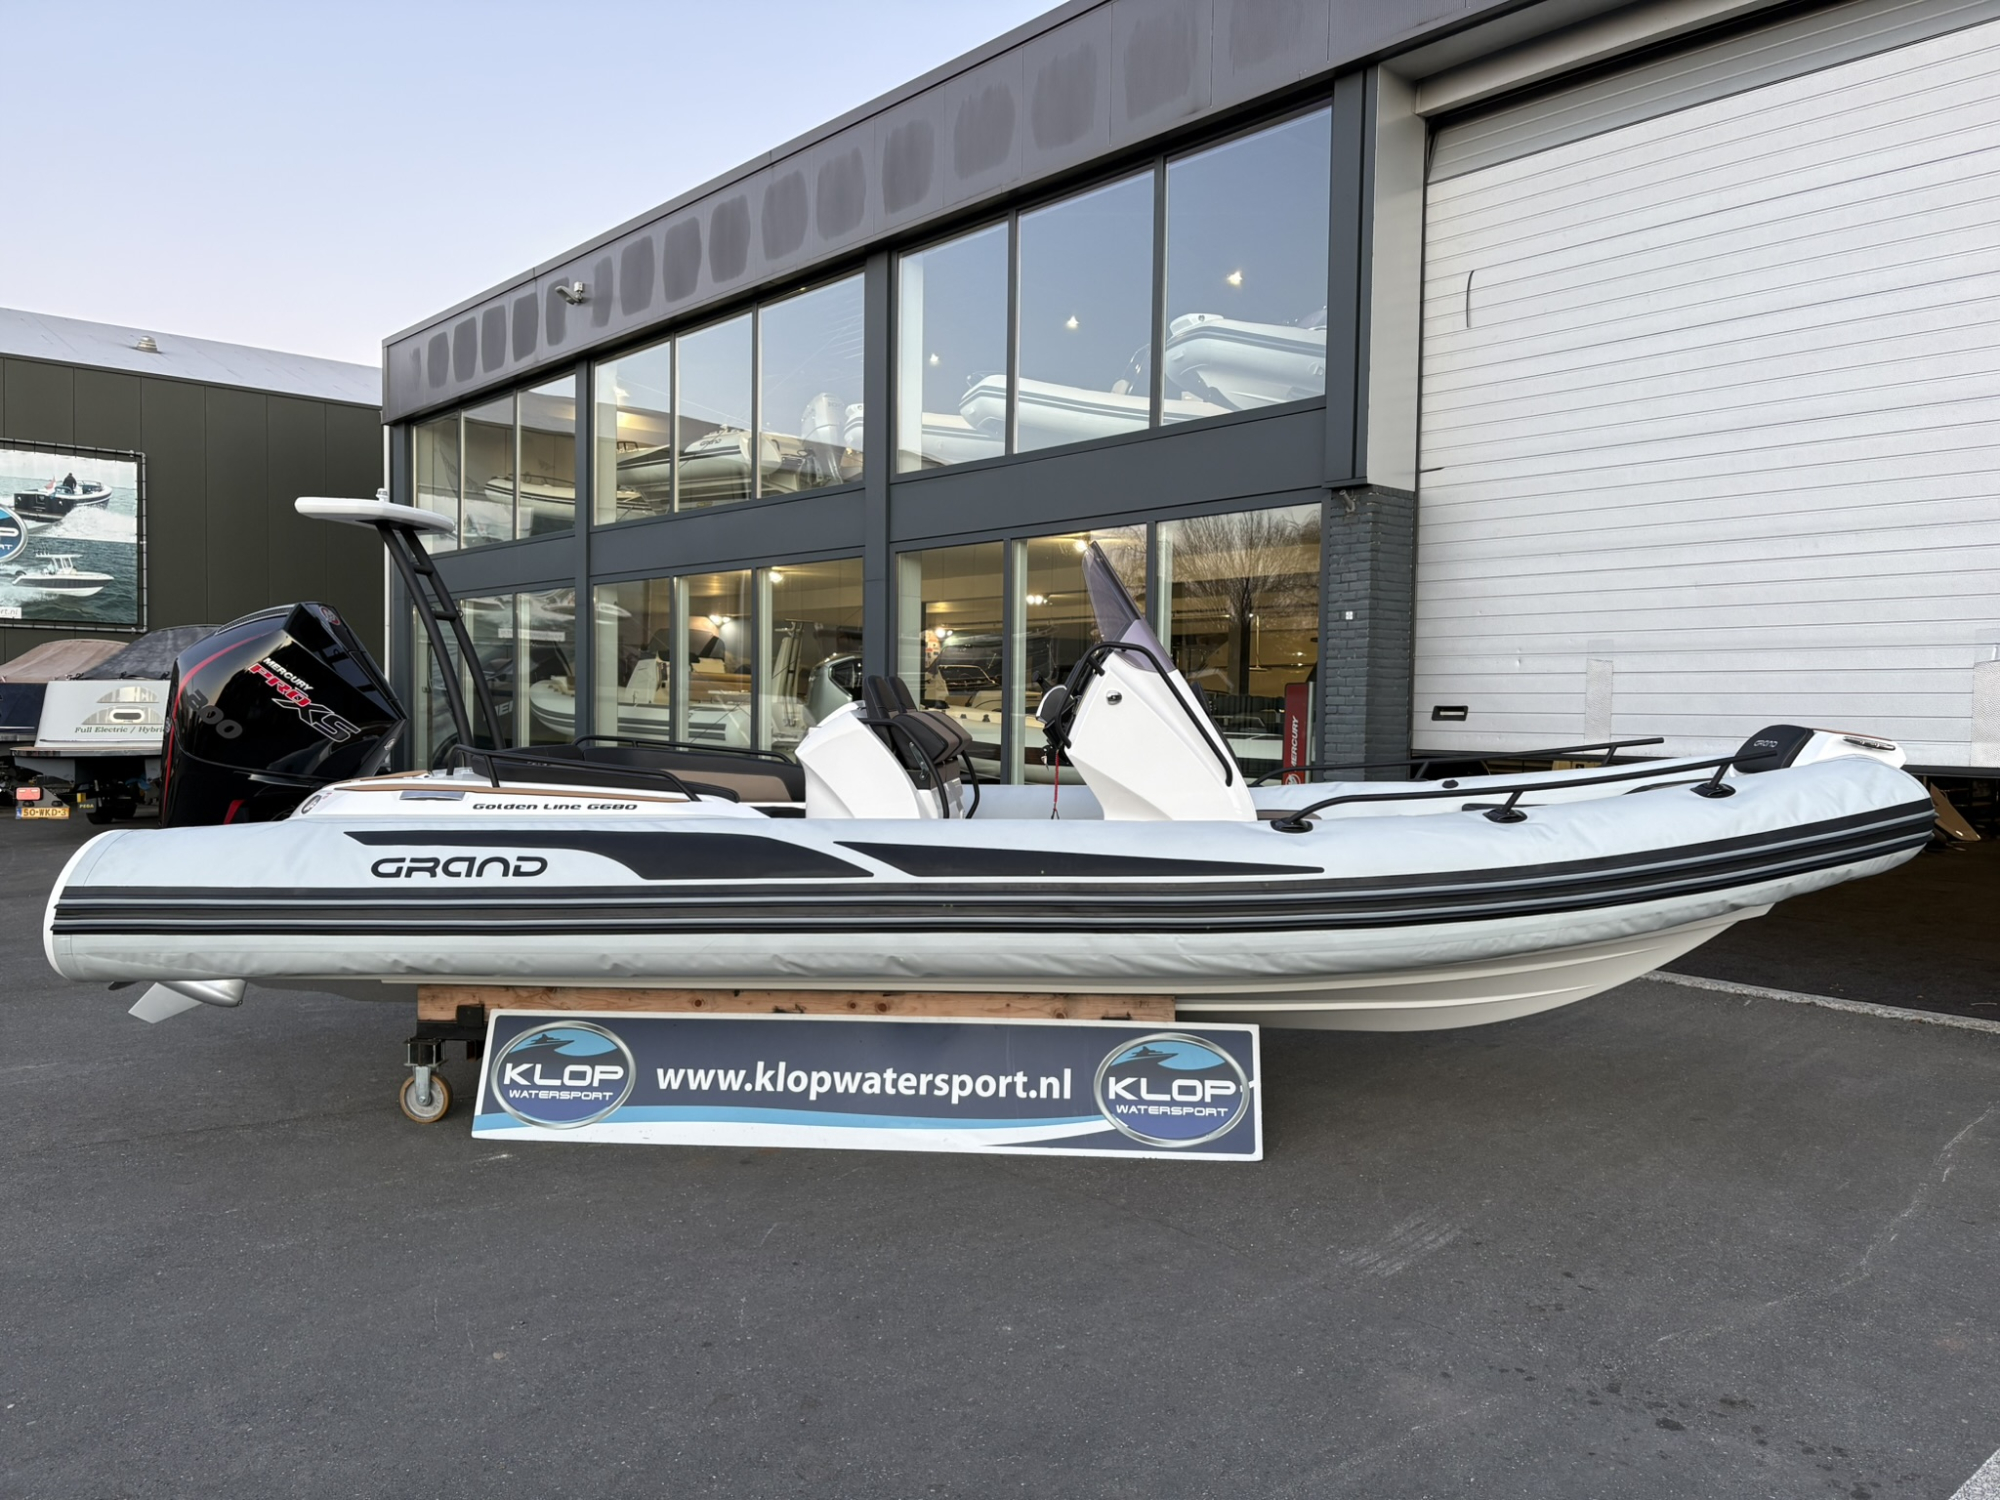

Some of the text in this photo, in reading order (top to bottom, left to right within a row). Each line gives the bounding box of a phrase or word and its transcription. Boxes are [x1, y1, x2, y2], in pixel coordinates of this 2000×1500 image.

[248, 663, 311, 707] PRO
[263, 657, 314, 691] MERCURY
[187, 689, 243, 739] 200
[271, 698, 361, 742] XS
[371, 856, 548, 878] GRAND
[503, 1062, 624, 1087] KLOP
[656, 1061, 1072, 1104] www.klopwatersport.nl
[1108, 1076, 1237, 1103] KLOP
[509, 1089, 613, 1100] WATERSPORT
[1116, 1104, 1228, 1117] WATERSPORT
